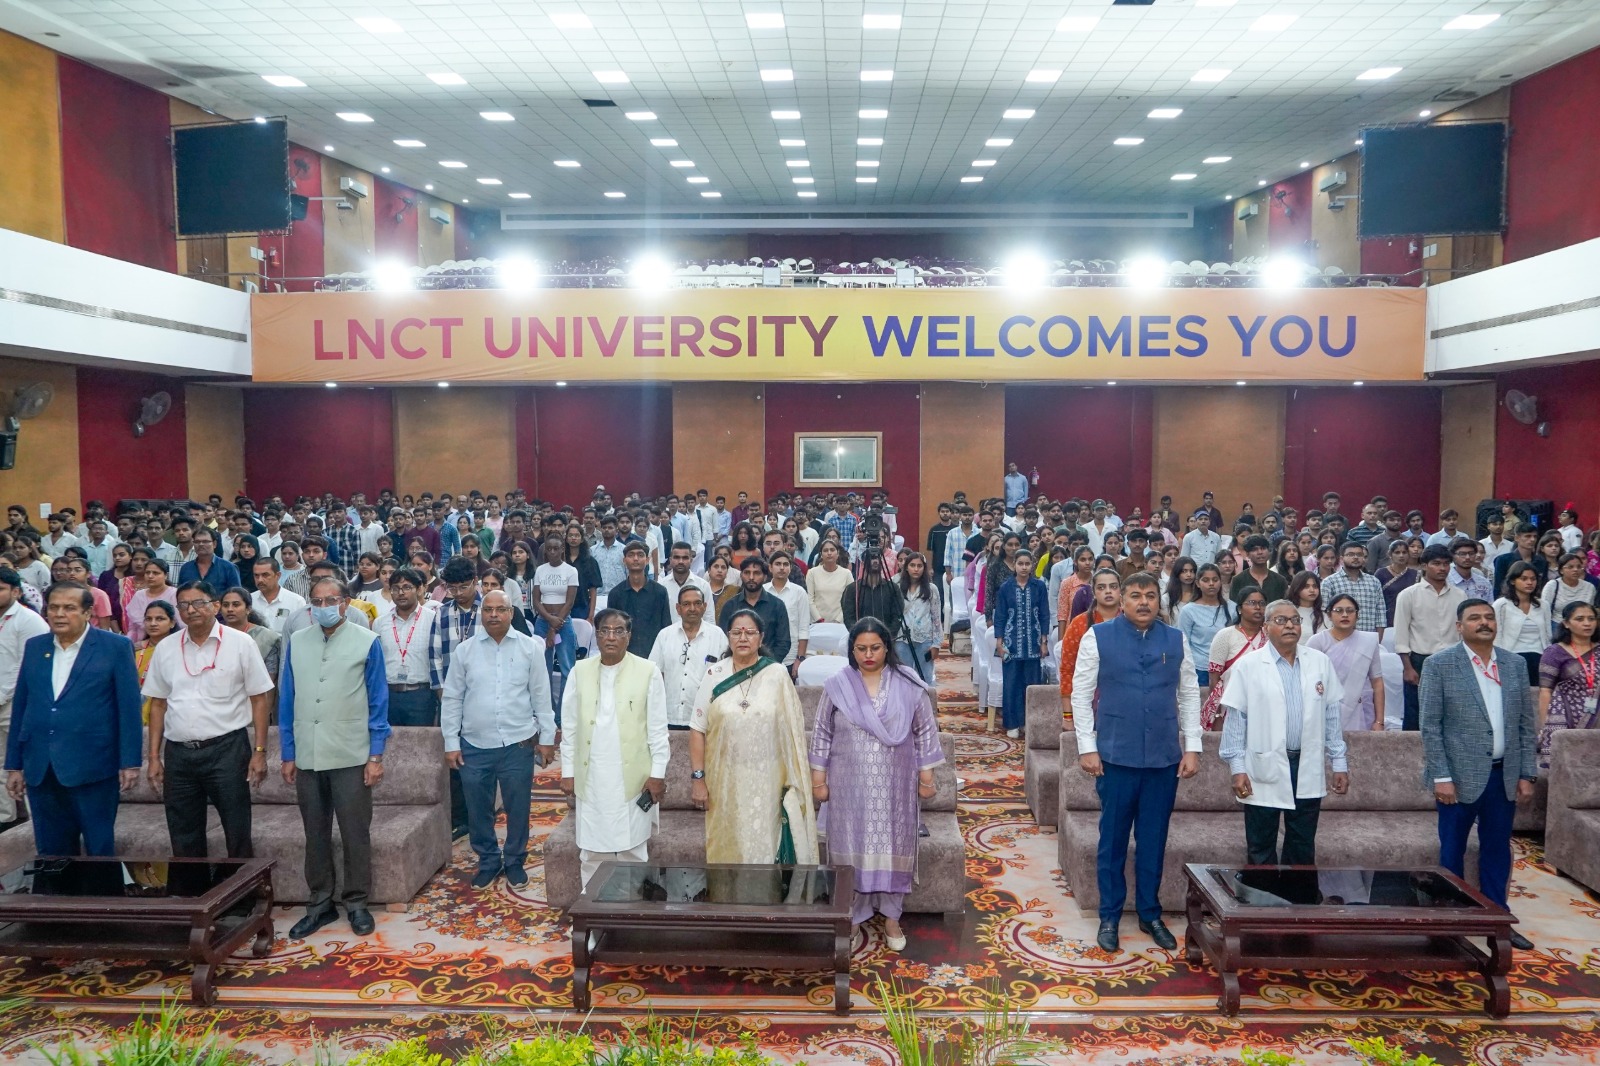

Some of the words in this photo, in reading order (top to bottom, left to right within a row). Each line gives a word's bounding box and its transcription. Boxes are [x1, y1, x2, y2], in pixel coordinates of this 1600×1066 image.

[314, 317, 463, 360] LNCT
[485, 316, 839, 358] UNIVERSITY
[863, 315, 1208, 358] WELCOMES
[1228, 315, 1357, 358] YOU
